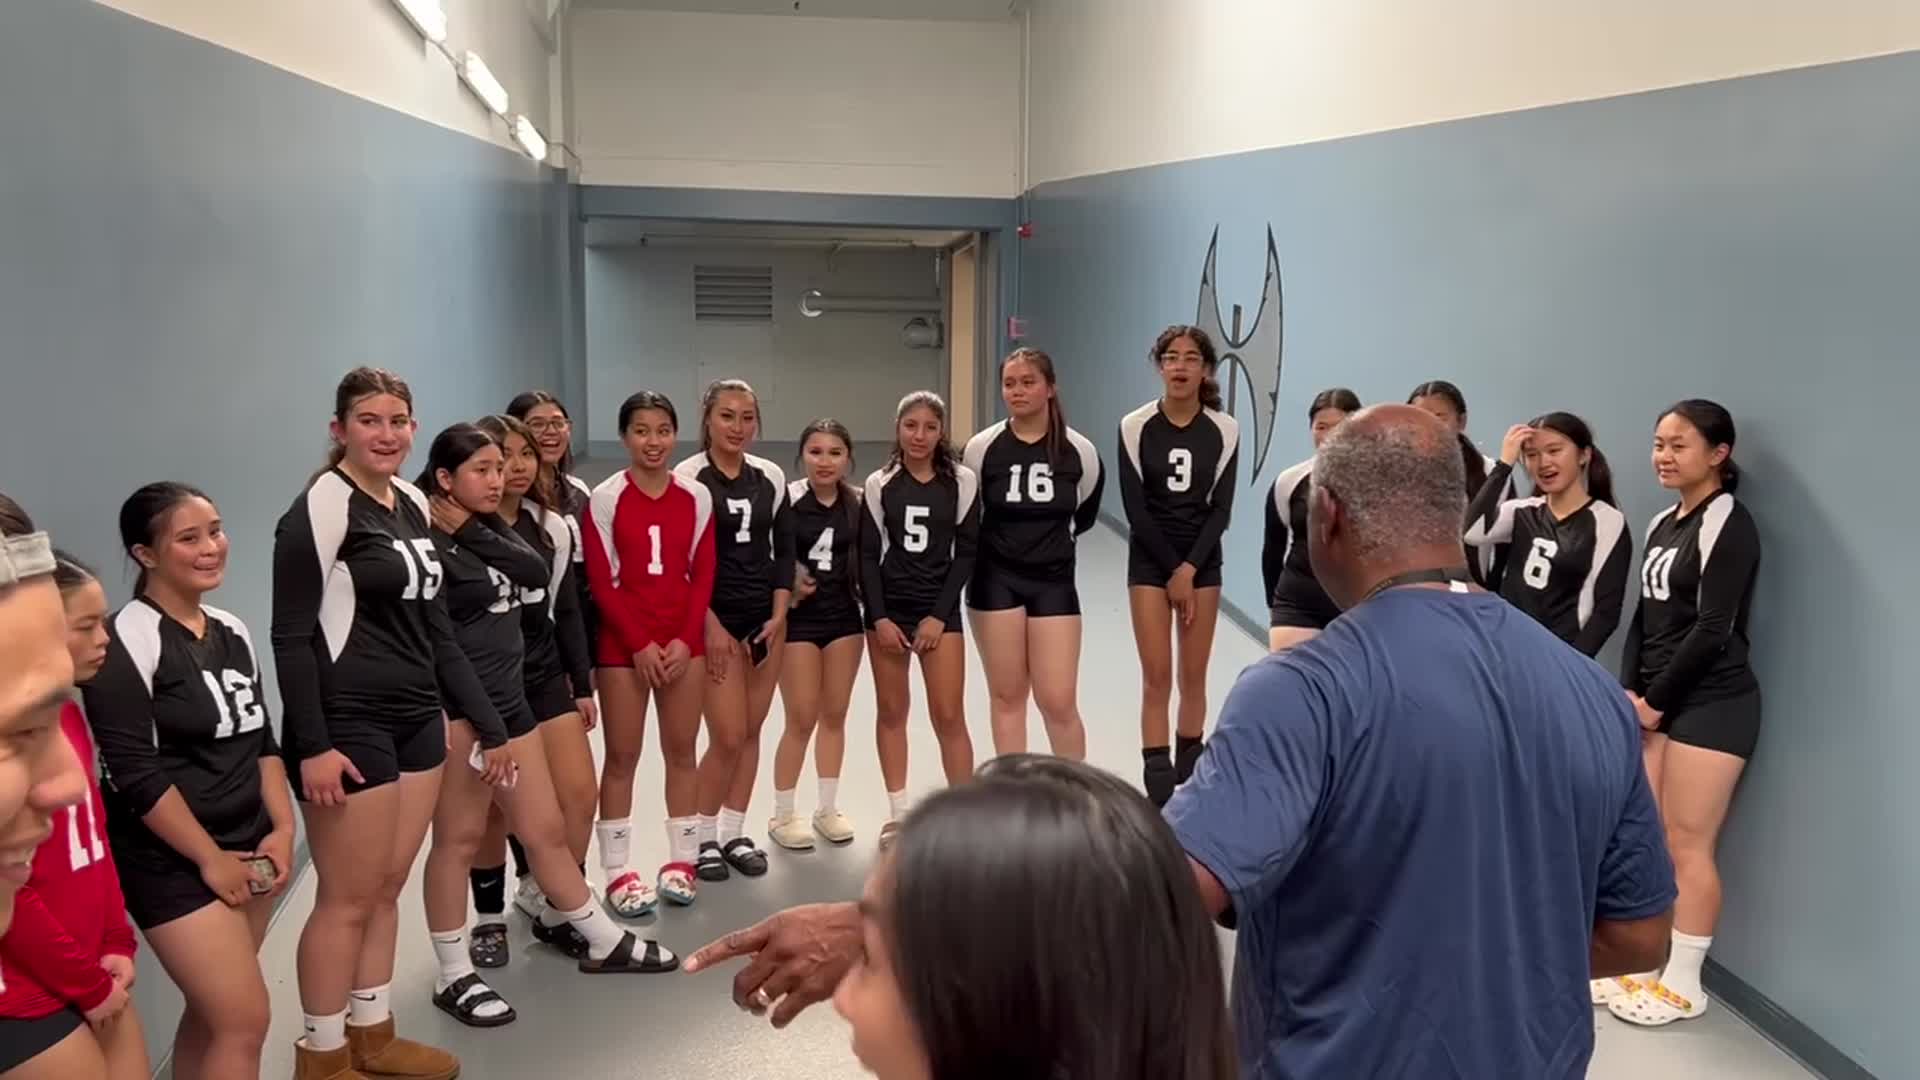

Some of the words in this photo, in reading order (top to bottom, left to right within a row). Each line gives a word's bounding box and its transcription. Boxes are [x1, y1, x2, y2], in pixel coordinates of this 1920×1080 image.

[1005, 462, 1055, 503] 16
[1166, 447, 1193, 492] 3
[726, 497, 752, 543] 7
[903, 505, 930, 553] 5
[392, 537, 444, 601] 15
[647, 525, 663, 575] 1
[808, 527, 835, 571] 4
[1523, 536, 1558, 590] 6
[1642, 546, 1679, 601] 10
[202, 668, 265, 739] 12
